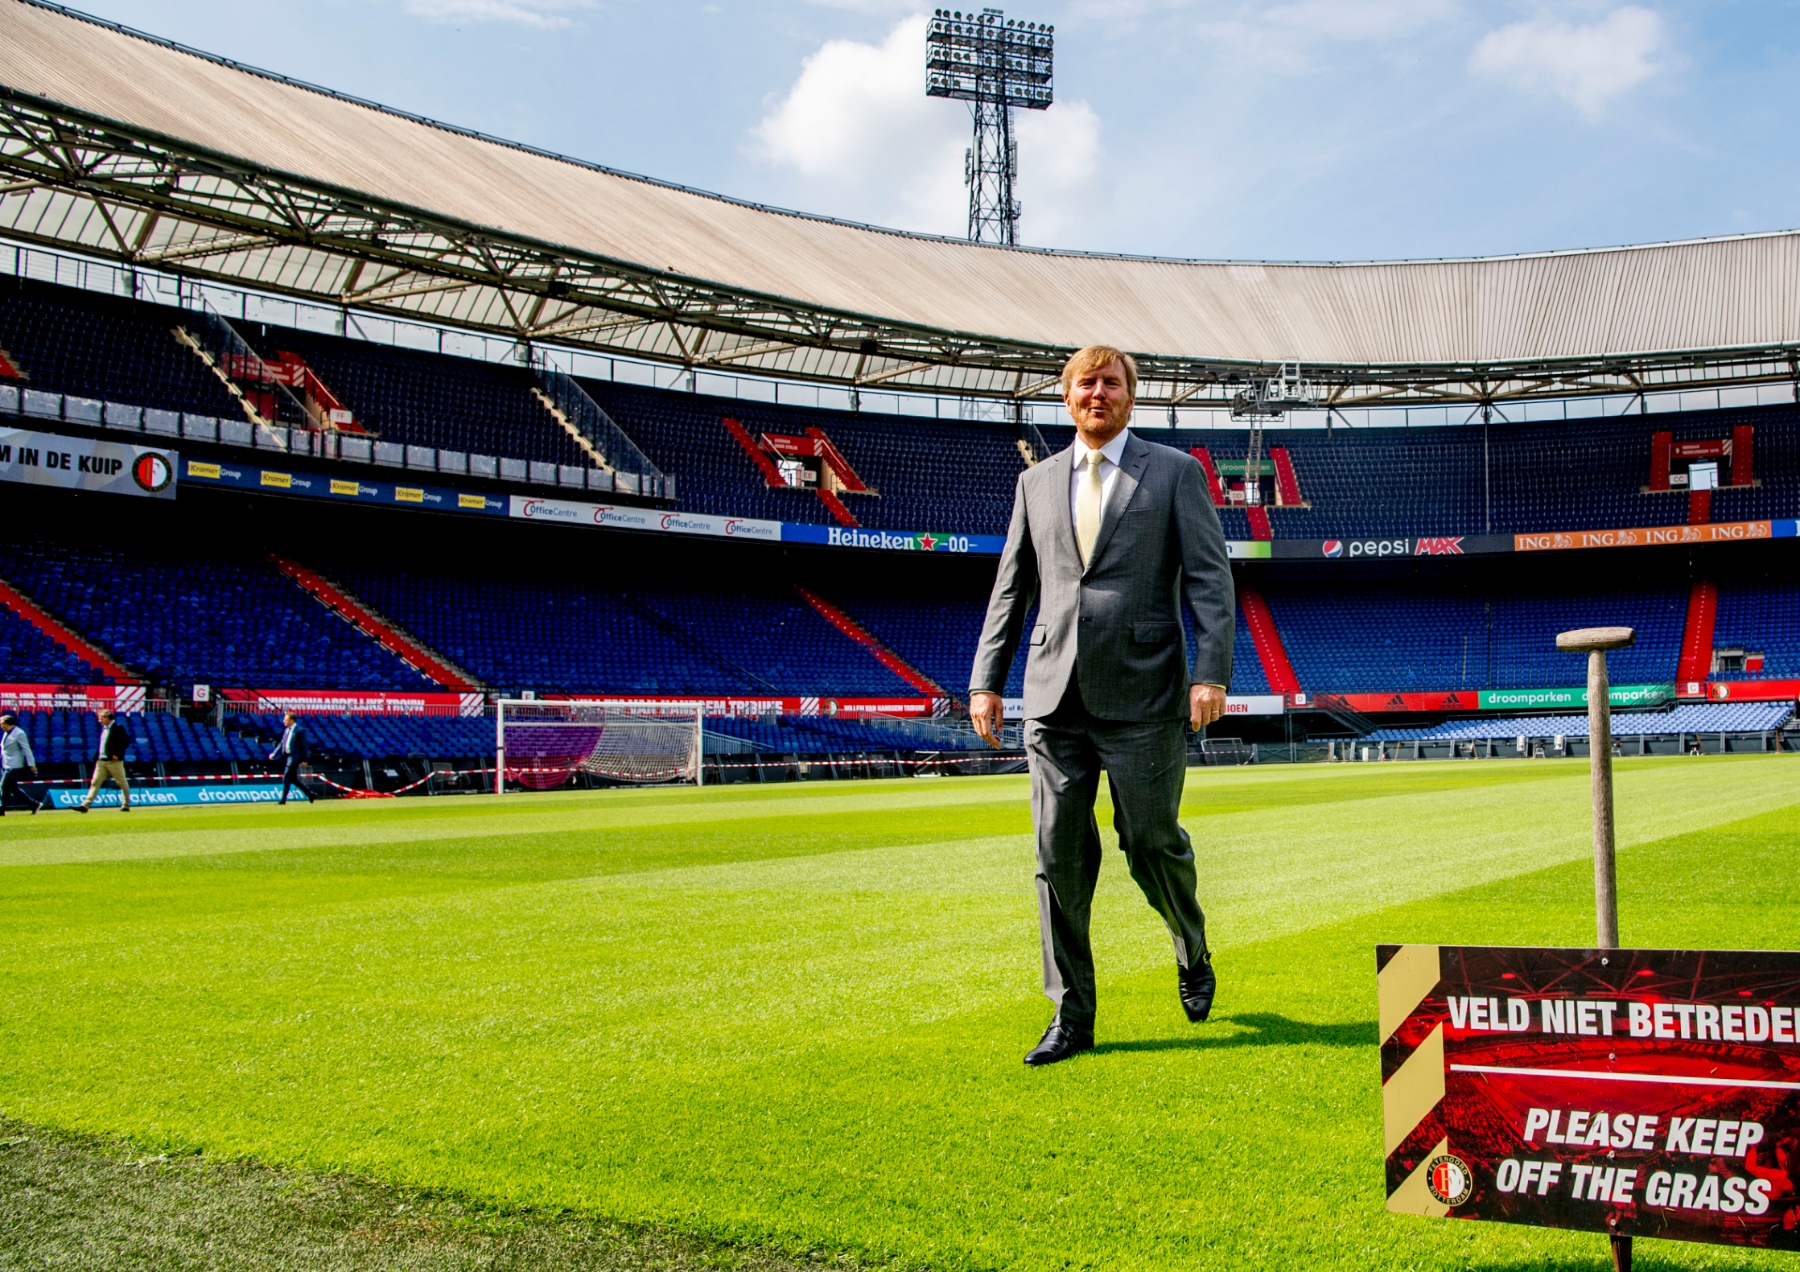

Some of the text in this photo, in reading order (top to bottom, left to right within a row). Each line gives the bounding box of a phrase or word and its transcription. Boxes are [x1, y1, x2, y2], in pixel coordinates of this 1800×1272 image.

[18, 447, 39, 466] IN
[46, 450, 71, 470] DE
[78, 454, 122, 475] KUIP
[220, 469, 242, 479] Group
[803, 471, 813, 480] EE
[291, 478, 311, 488] Group
[358, 486, 378, 496] Group
[423, 493, 442, 503] Group
[485, 499, 503, 509] Group
[827, 526, 916, 551] Heineken
[1582, 533, 1614, 547] ING
[1645, 530, 1678, 544] ING
[1710, 526, 1744, 540] ING
[1349, 536, 1465, 557] pepsi MAX
[1518, 536, 1550, 549] ING
[196, 688, 206, 698] G
[1488, 690, 1571, 706] droomparken
[727, 701, 783, 715] TRIBUNE
[1447, 996, 1530, 1032] VELD
[1542, 1000, 1616, 1036] NIET
[1524, 1108, 1763, 1157] PLEASE KEEP
[1428, 1156, 1468, 1175] FEYENOORD
[1497, 1159, 1771, 1215] OFF THE GRASS
[1430, 1185, 1469, 1205] ROTTERDAM
